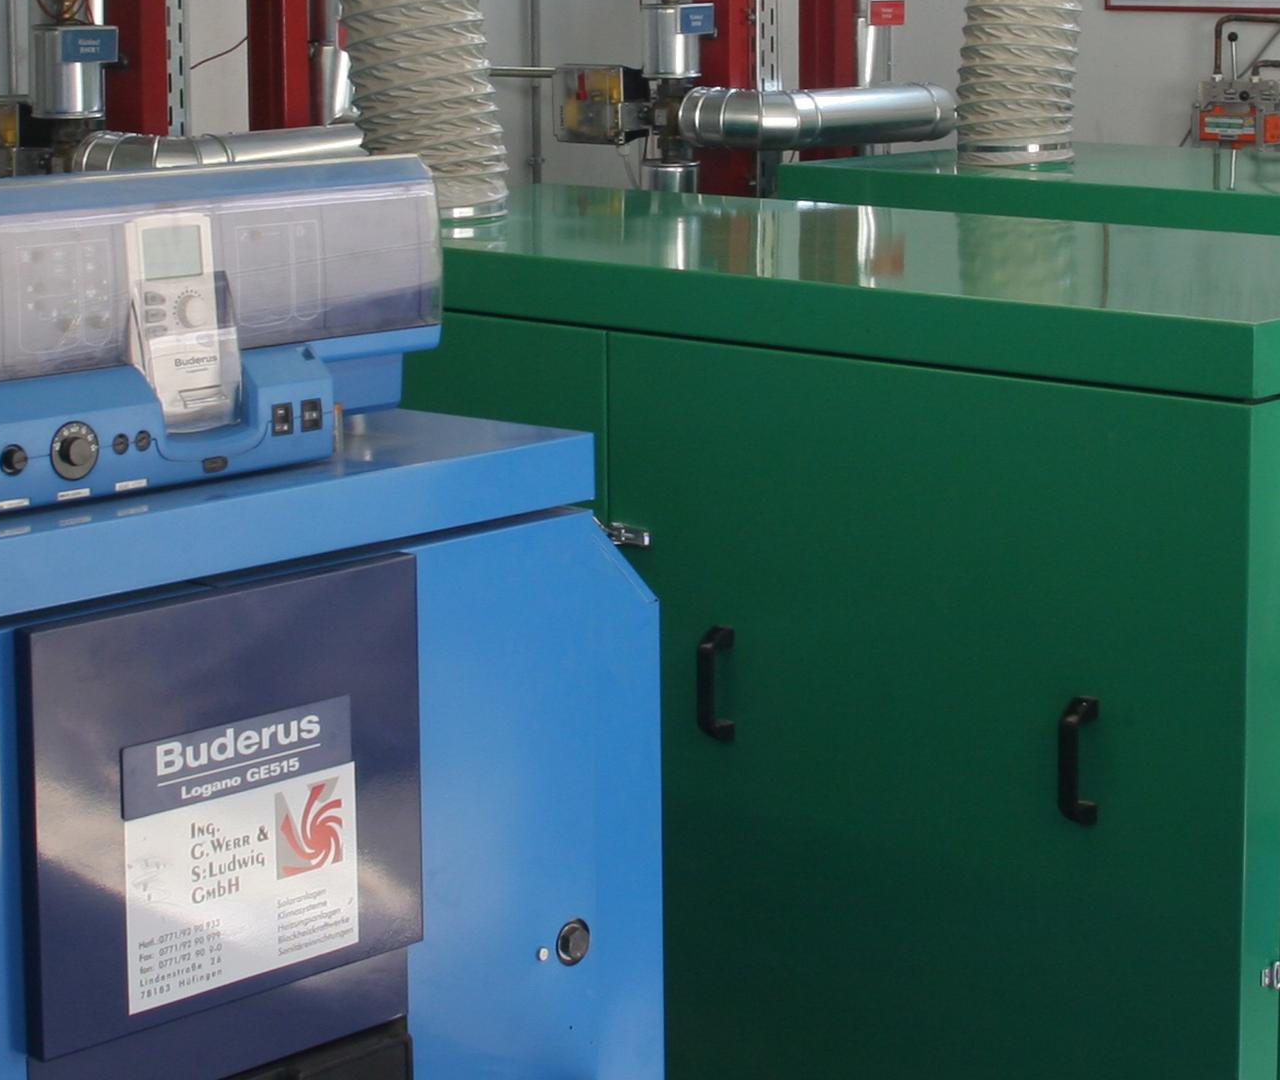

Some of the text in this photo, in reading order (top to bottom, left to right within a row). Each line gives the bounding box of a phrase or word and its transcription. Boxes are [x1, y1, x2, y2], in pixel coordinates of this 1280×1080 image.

[174, 354, 218, 368] Buderus
[156, 714, 321, 777] Buderus
[180, 757, 300, 800] Logano GE515
[257, 825, 269, 842] &
[178, 968, 223, 988] Hüfingen
